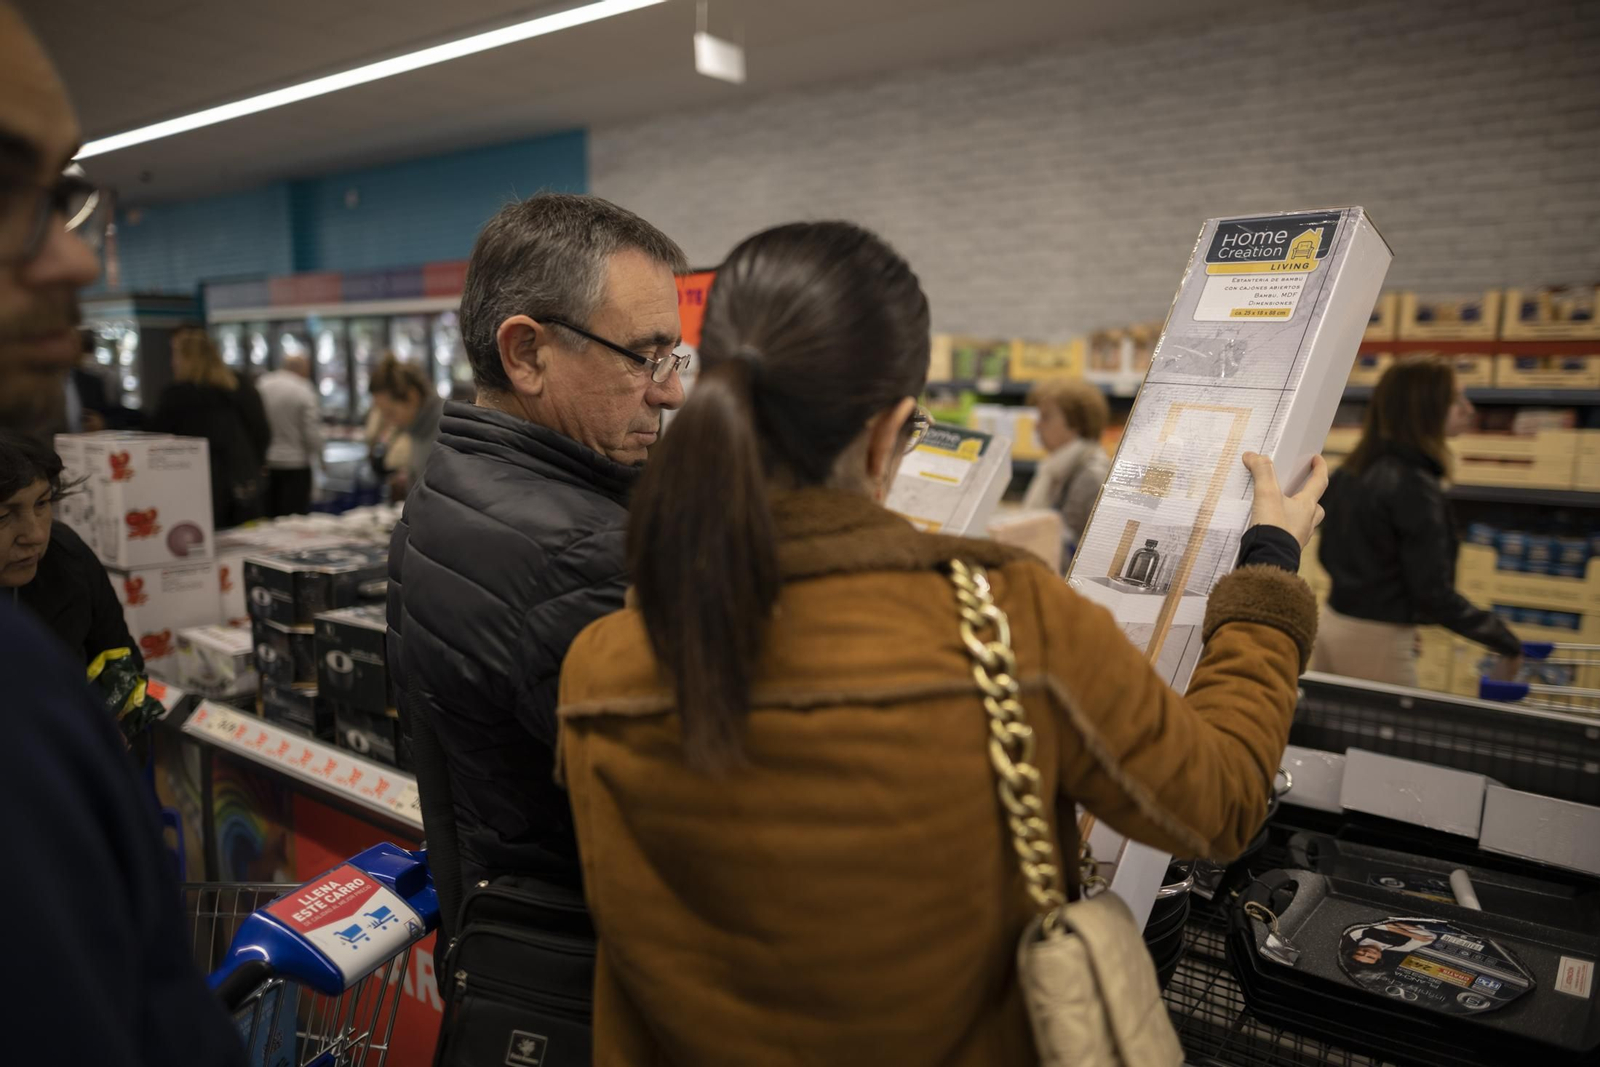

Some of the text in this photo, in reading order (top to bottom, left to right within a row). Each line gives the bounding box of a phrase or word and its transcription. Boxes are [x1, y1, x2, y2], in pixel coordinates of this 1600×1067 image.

[1221, 230, 1288, 247] Home
[1218, 245, 1283, 260] Creation
[1270, 262, 1310, 271] LIVING
[925, 428, 961, 444] ome
[291, 878, 366, 923] ESTE CARRO
[297, 881, 342, 906] LLENA
